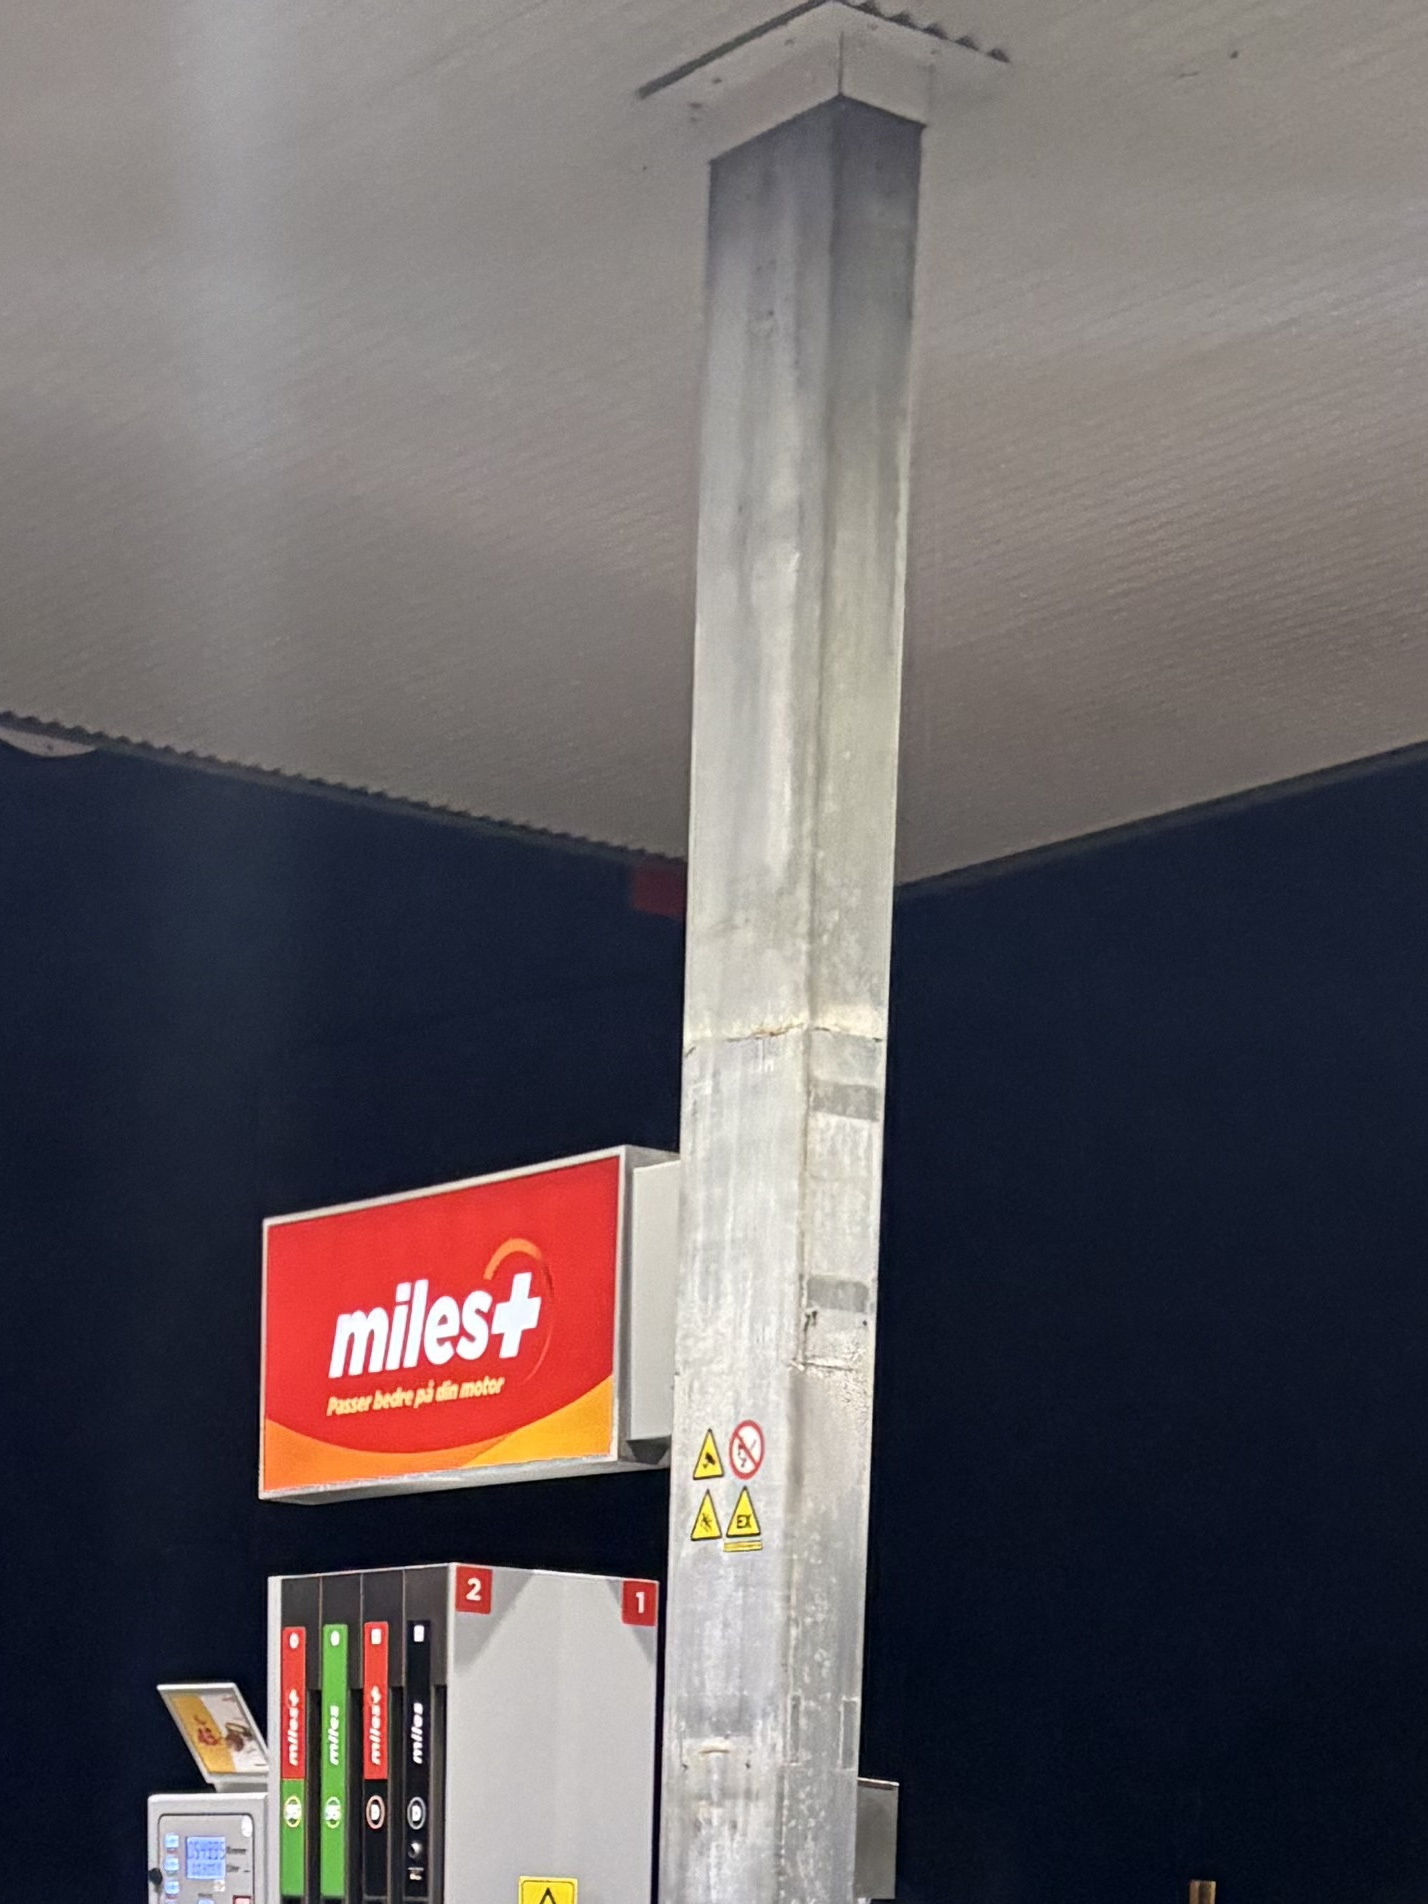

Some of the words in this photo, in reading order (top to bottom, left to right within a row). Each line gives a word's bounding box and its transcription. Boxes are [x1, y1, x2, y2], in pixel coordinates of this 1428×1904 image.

[328, 1272, 542, 1379] miles+
[327, 1395, 373, 1417] Passer
[373, 1386, 415, 1410] bedre
[414, 1379, 435, 1409] på
[435, 1379, 459, 1402] din
[459, 1375, 505, 1399] motor
[466, 1578, 481, 1600] 2
[635, 1591, 645, 1614] 1
[328, 1704, 340, 1766] miles
[410, 1702, 423, 1765] miles
